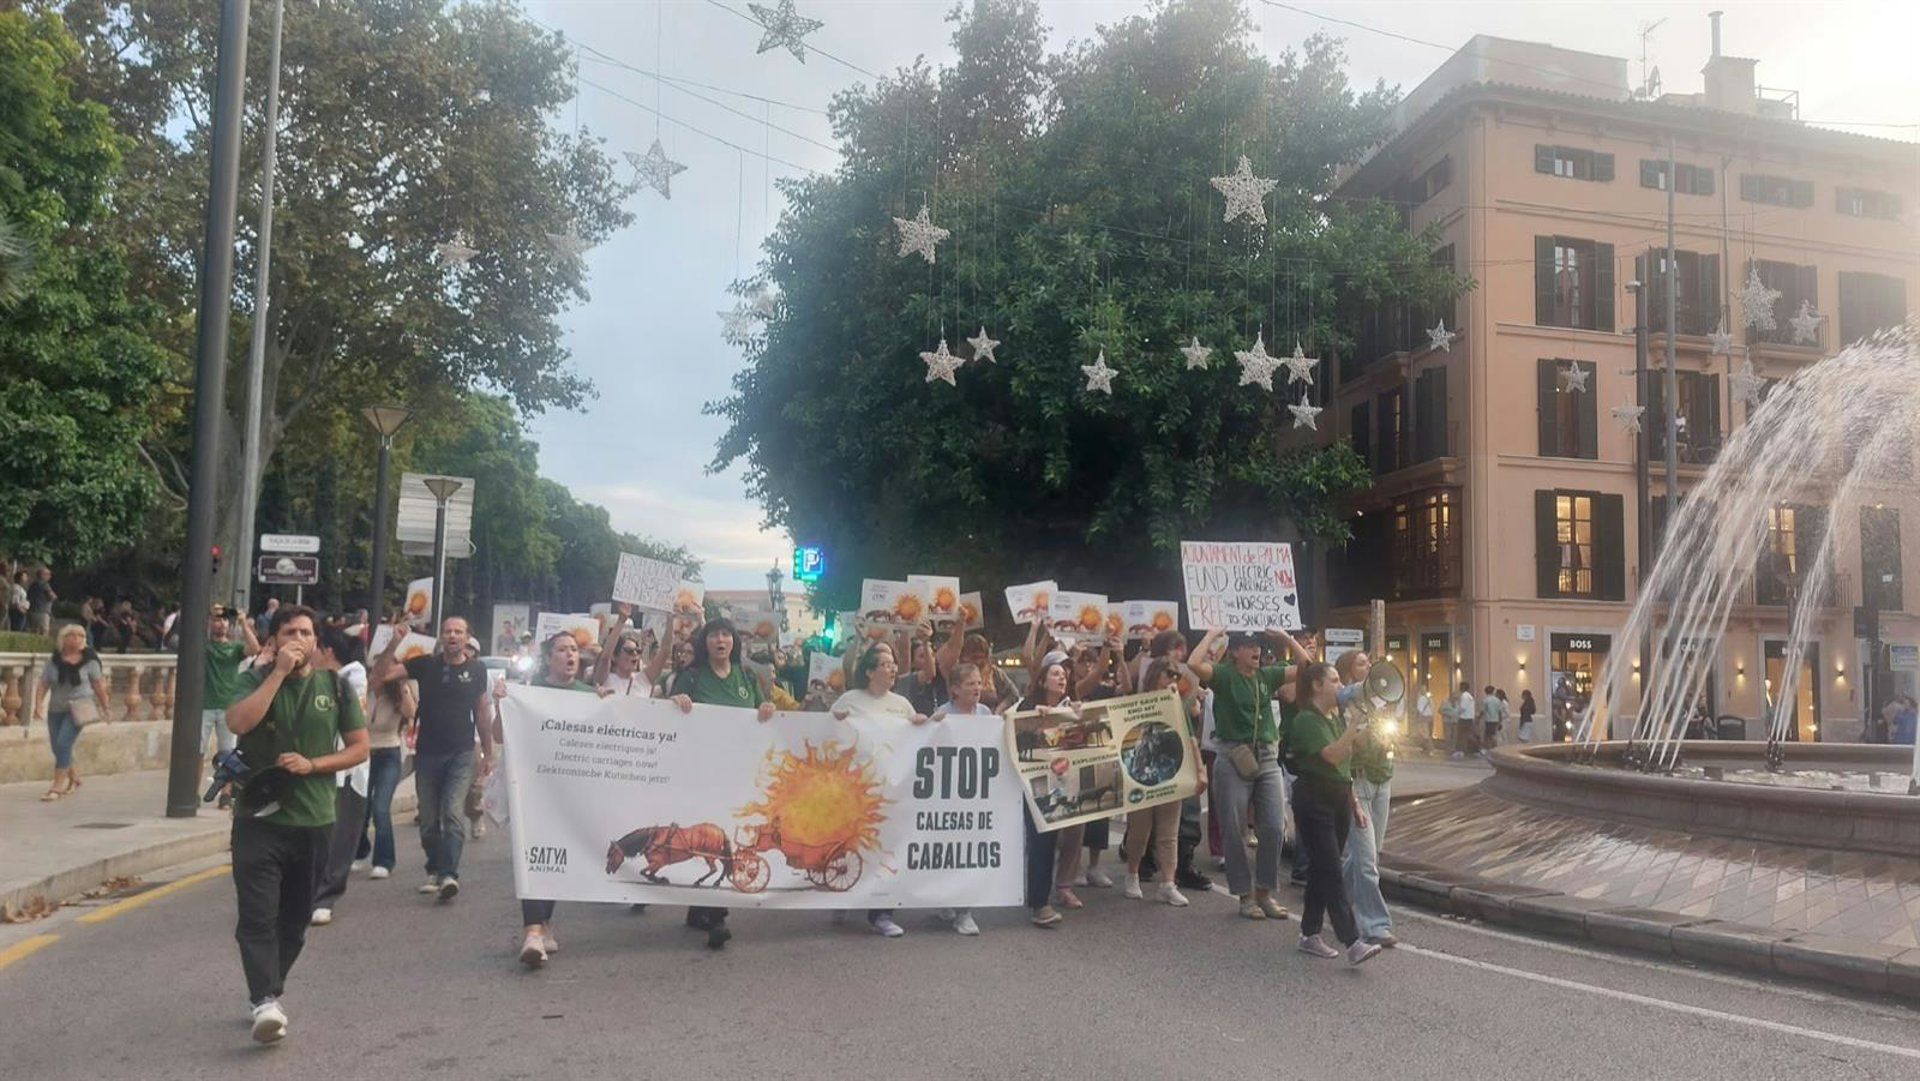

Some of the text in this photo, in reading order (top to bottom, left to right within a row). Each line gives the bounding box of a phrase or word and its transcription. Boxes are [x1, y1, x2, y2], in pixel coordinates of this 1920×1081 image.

[1258, 546, 1292, 564] PALMA
[1186, 565, 1229, 593] FUND
[1233, 564, 1273, 580] ELECTRIC
[1190, 594, 1223, 628] FREE
[1236, 595, 1280, 613] HORSES
[1570, 640, 1592, 649] BOSS
[541, 719, 677, 744] ¡Calesas eléctricas ya!
[554, 751, 590, 763] Electric
[592, 756, 633, 769] carriages
[913, 746, 1000, 799] STOP
[916, 811, 993, 830] CALESAS DE
[530, 847, 567, 864] SATYA
[907, 841, 1001, 870] CABALLOS
